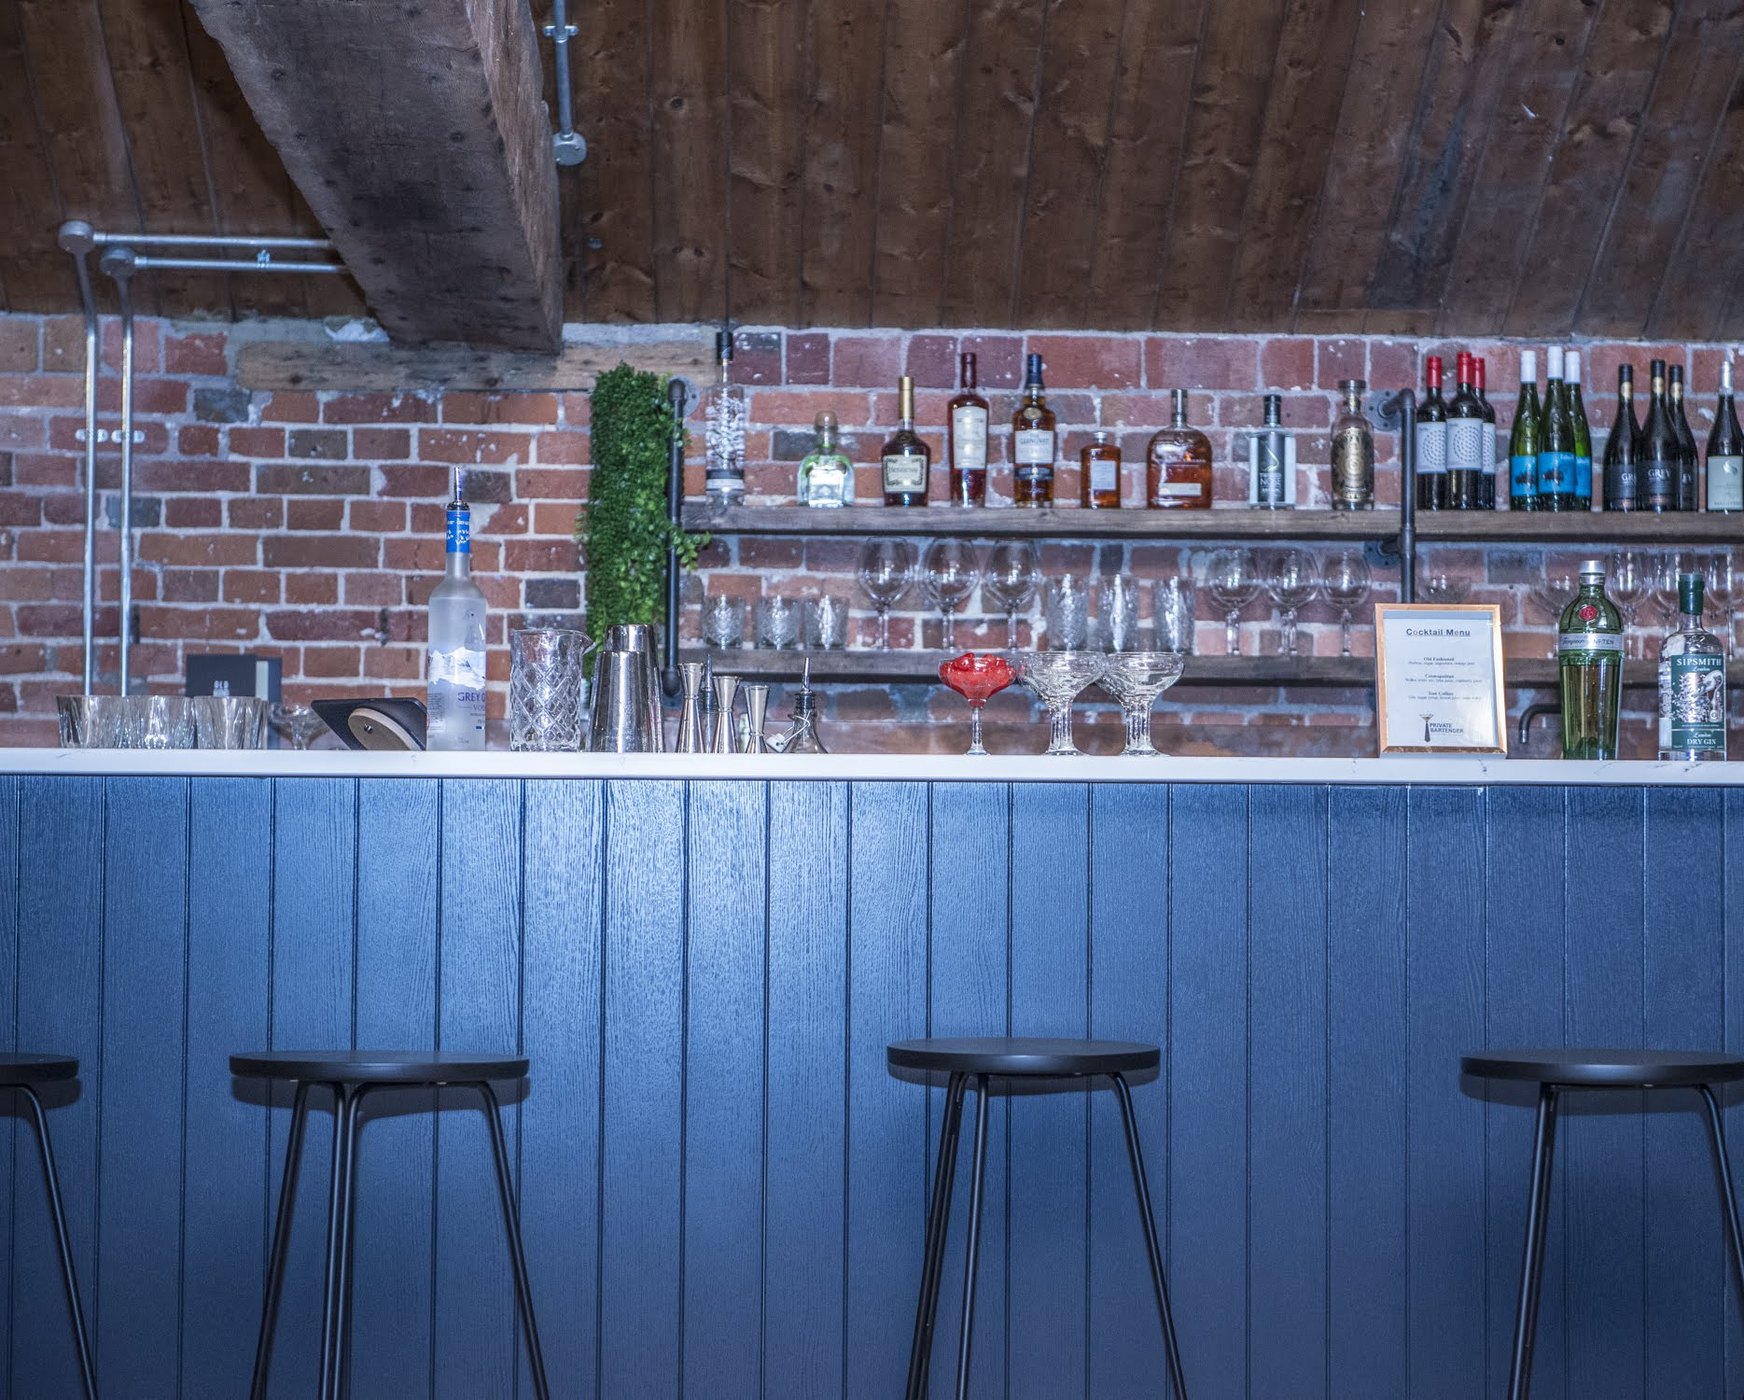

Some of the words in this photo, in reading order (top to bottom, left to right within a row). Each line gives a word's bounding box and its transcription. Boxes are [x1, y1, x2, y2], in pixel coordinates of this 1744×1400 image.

[1406, 628, 1443, 636] Cocktail
[1446, 628, 1471, 637] Menu
[1676, 657, 1722, 666] SIPSMITH
[457, 691, 481, 702] GREY
